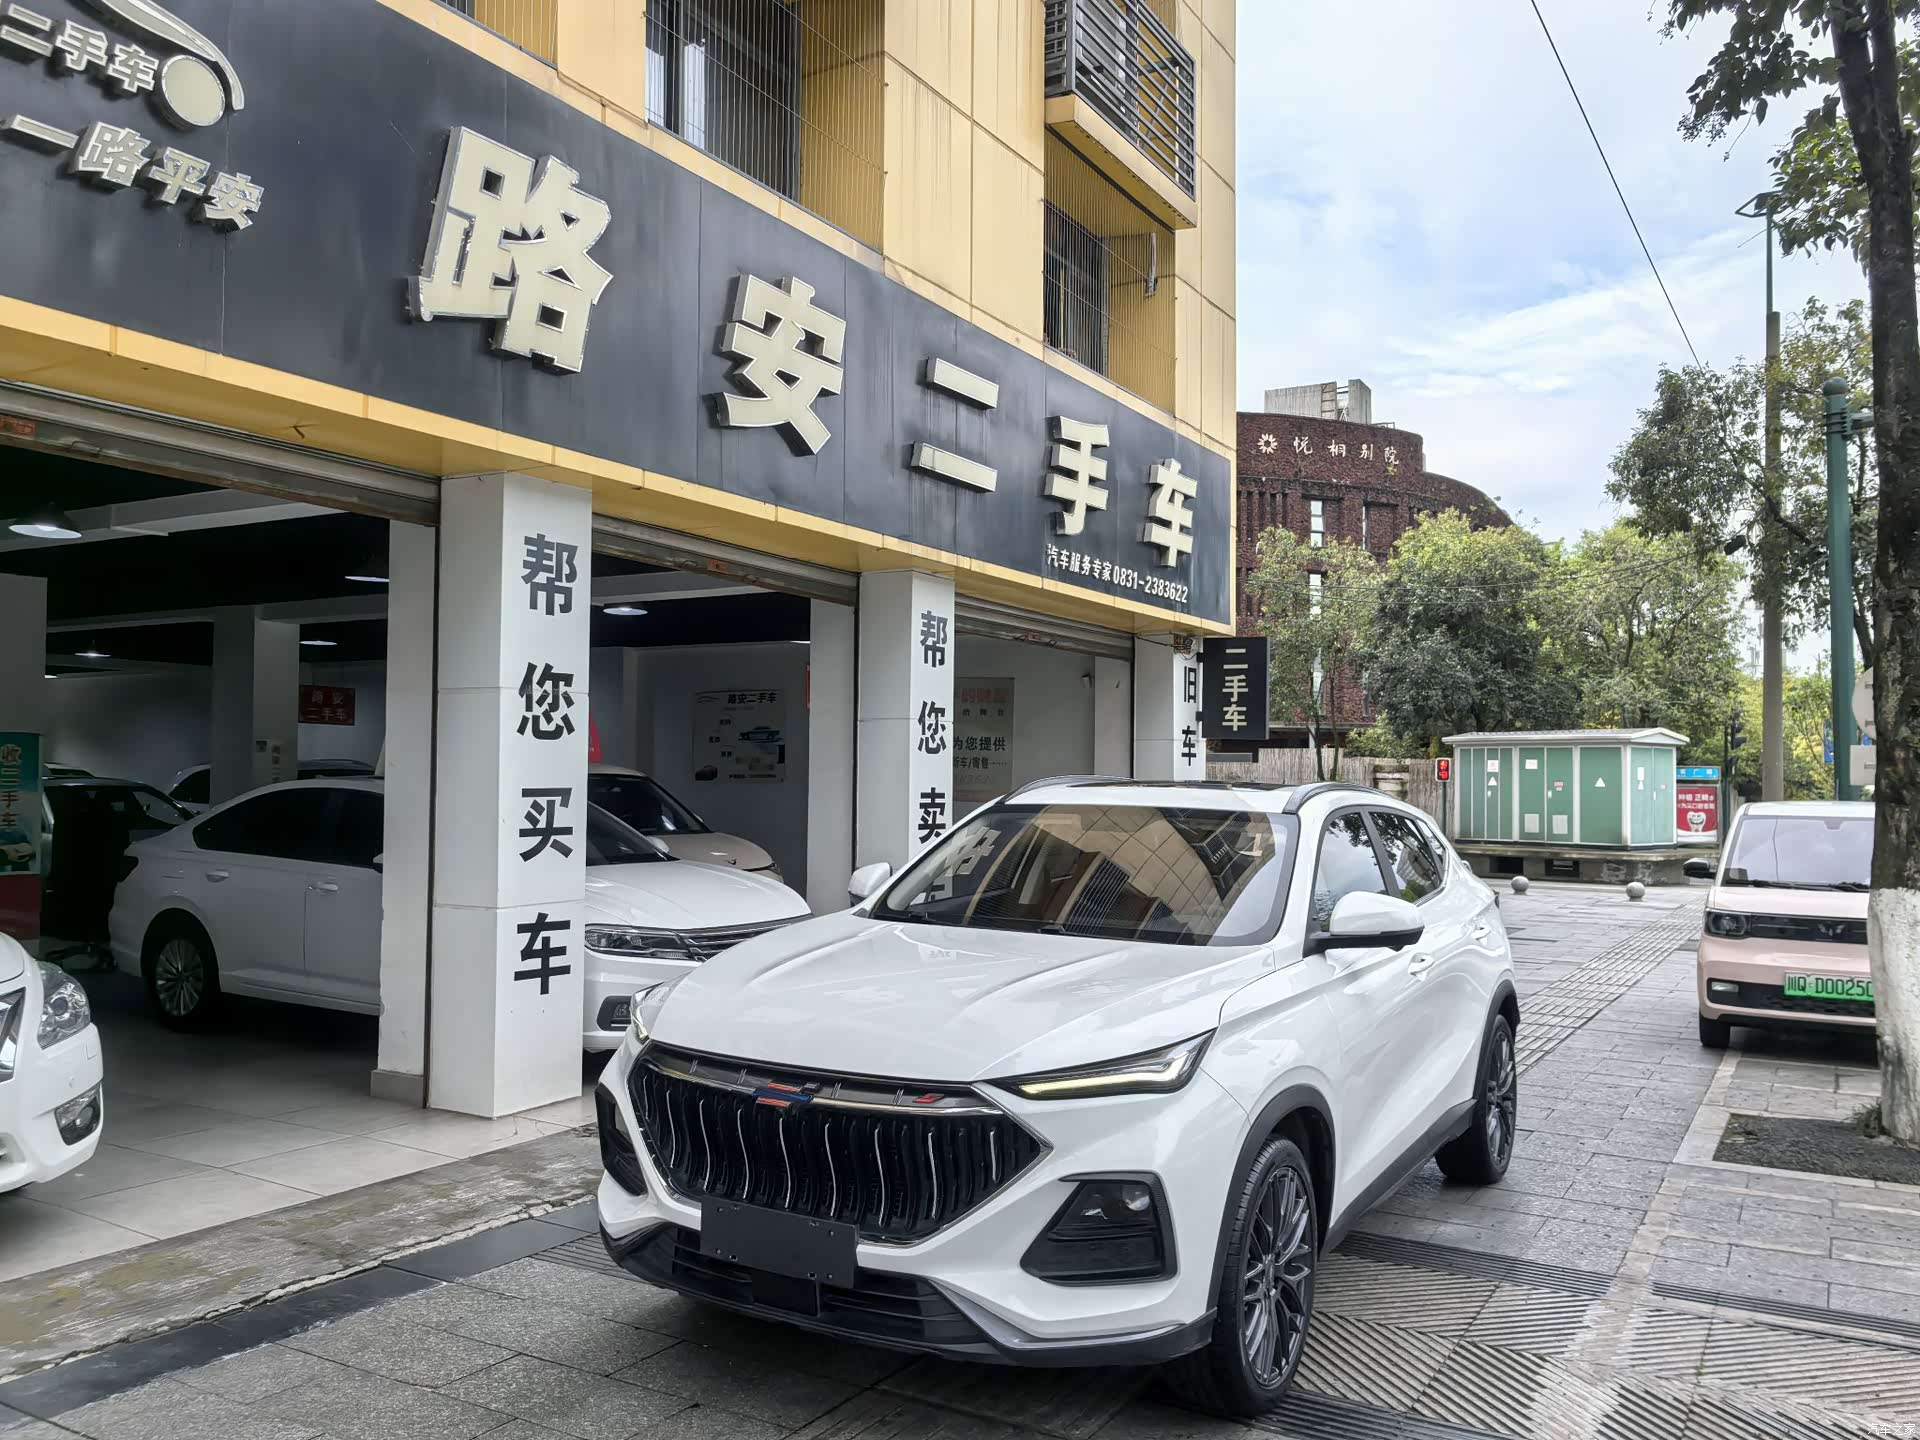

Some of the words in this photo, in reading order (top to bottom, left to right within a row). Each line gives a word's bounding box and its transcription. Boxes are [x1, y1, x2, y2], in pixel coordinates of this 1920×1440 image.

[0, 3, 160, 93] 二手车
[10, 114, 265, 230] 一路平安
[412, 125, 1198, 567] 路安二手车
[1181, 666, 1197, 766] 旧车
[1222, 648, 1248, 731] 二手车
[514, 533, 578, 995] 帮您买车
